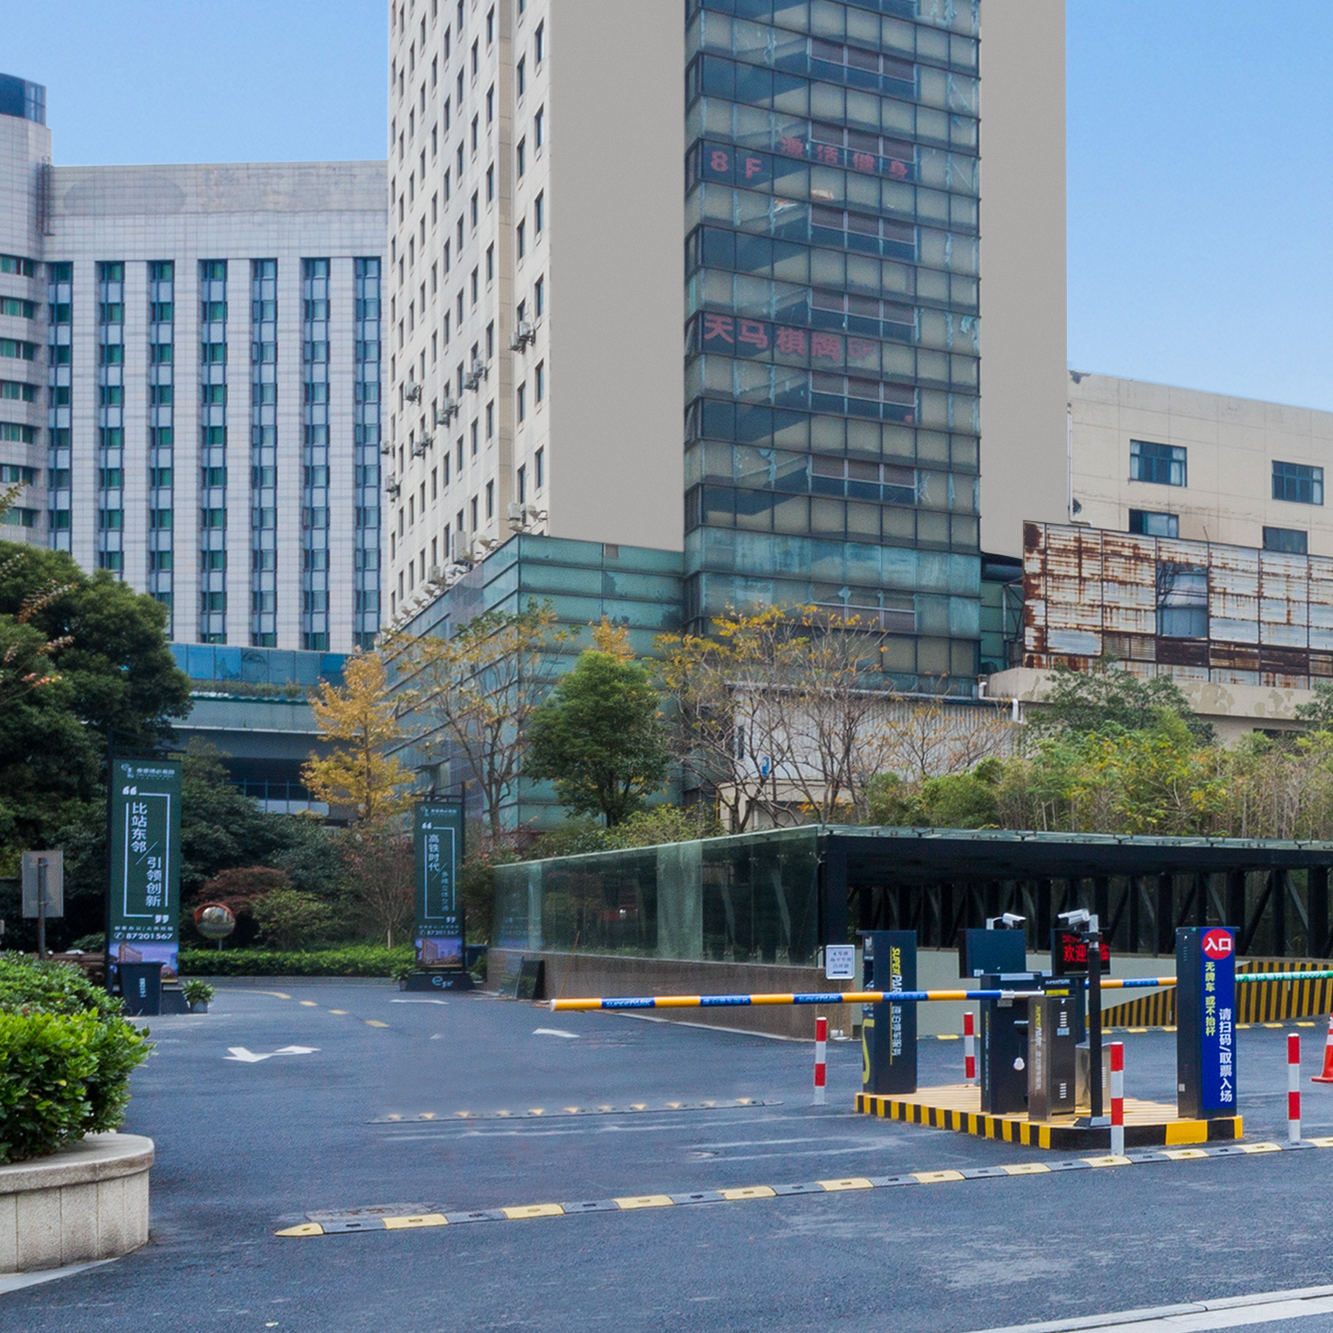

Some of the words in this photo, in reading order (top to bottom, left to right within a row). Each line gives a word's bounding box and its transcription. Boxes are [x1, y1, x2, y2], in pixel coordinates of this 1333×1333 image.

[704, 315, 841, 362] 天马棋牌
[131, 802, 147, 853] 比站东邻
[428, 834, 440, 872] 高铁时代
[146, 857, 162, 907] 引领创新
[125, 932, 173, 940] 87201567
[1063, 944, 1109, 962] 欢迎临
[1204, 938, 1232, 952] 入口
[892, 947, 903, 993] SUPERPAR
[1205, 961, 1215, 992] 无牌车
[1219, 1008, 1232, 1103] 请扫码/取票入场
